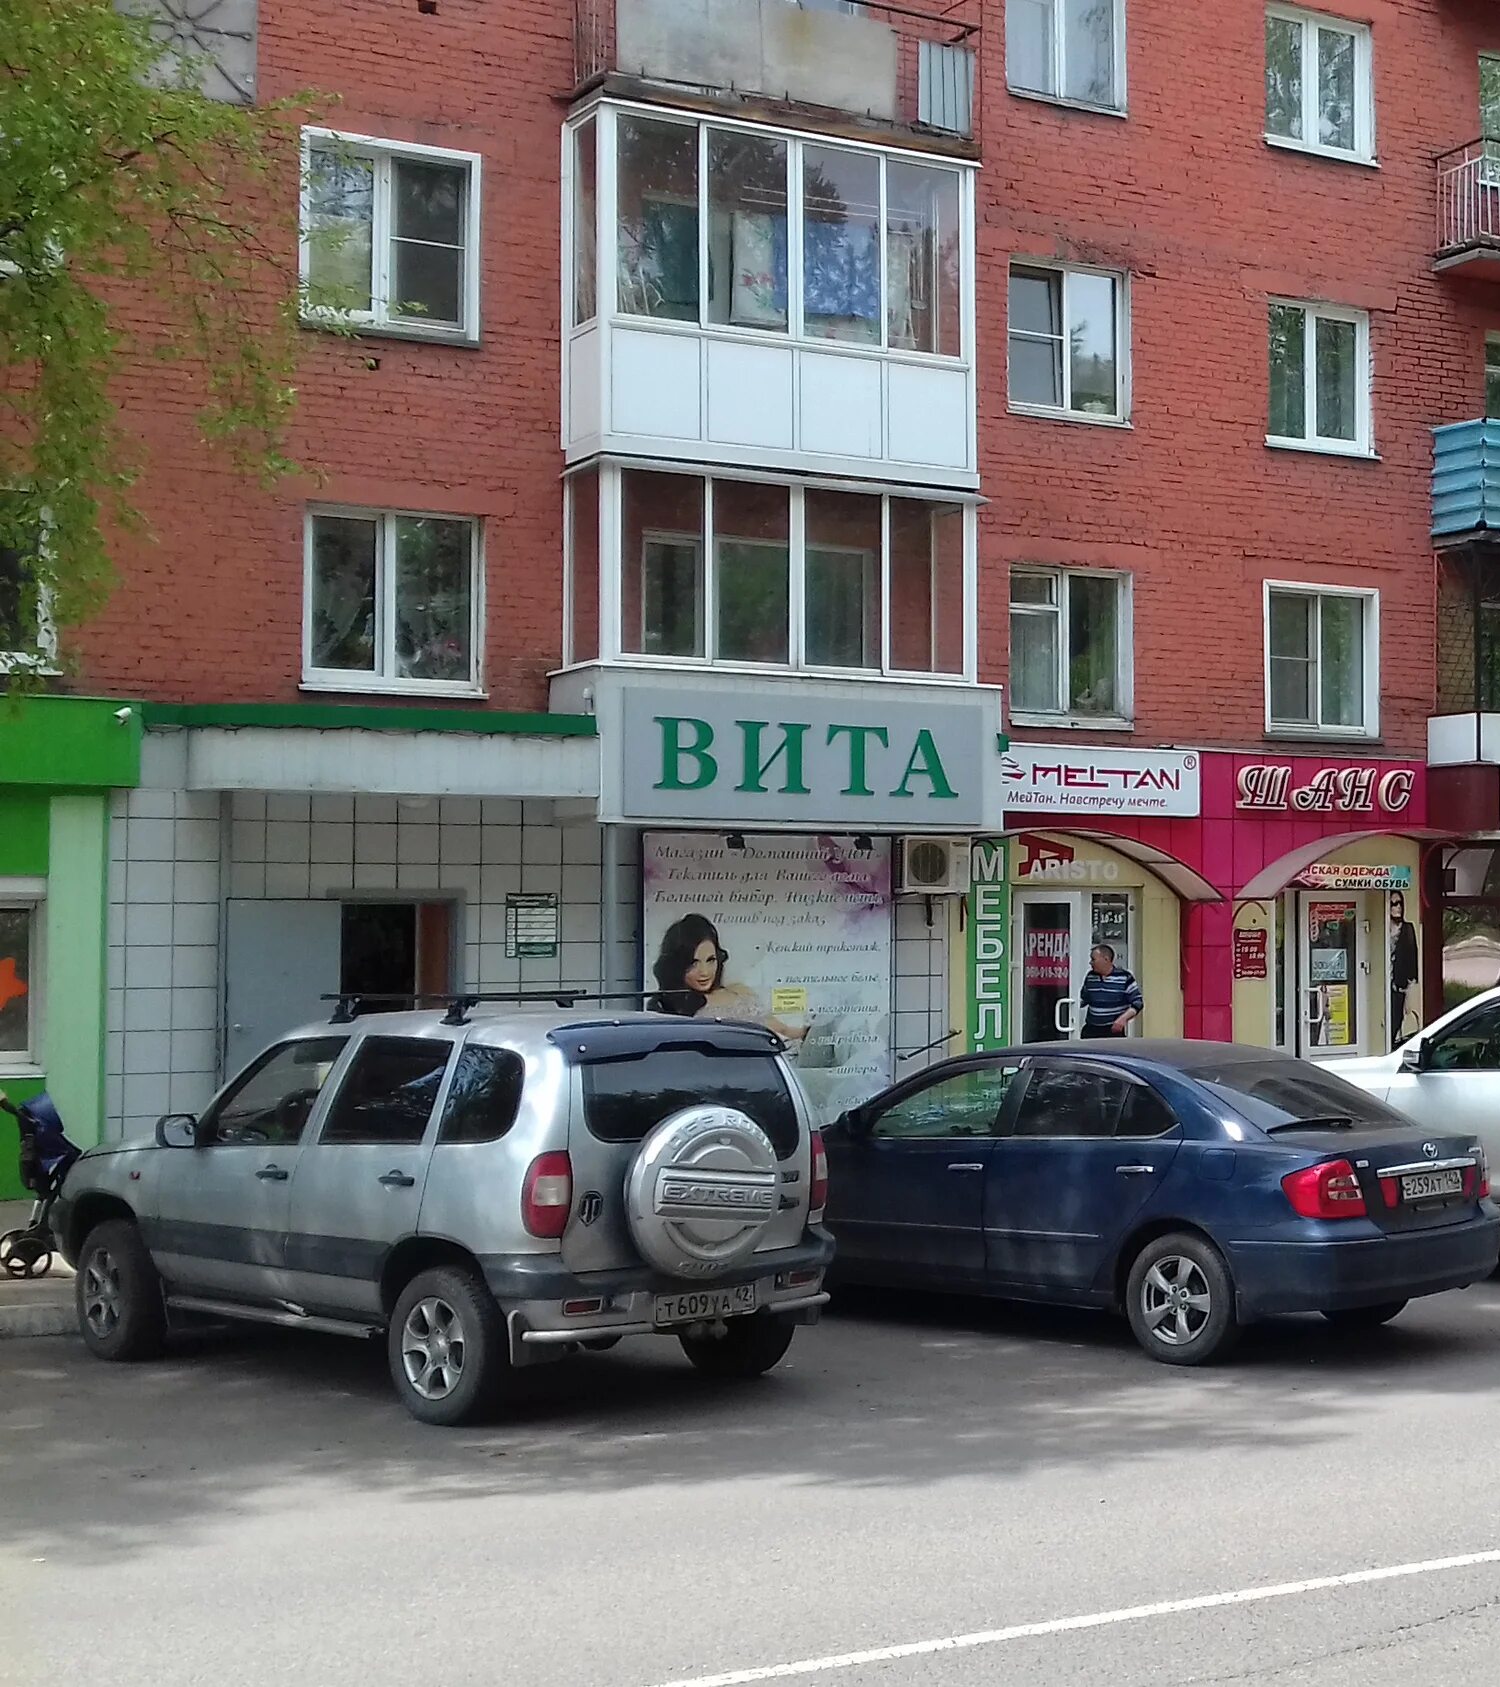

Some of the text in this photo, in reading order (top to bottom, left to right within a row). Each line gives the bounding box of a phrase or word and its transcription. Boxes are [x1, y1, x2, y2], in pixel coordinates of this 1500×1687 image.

[653, 716, 959, 798] ВИТА
[1236, 765, 1415, 811] ШАНС
[1007, 791, 1167, 808] МейТан. Навстречу мечте.
[655, 846, 724, 860] Магазин
[667, 867, 738, 880] Текстиль
[740, 870, 768, 882] для
[776, 868, 826, 881] Вашего
[1029, 859, 1119, 880] ARISTO
[1343, 866, 1390, 876] ОДЕЖДА
[1335, 878, 1409, 888] СУМКИ ОБУВЬ
[654, 889, 724, 903] Большой
[785, 890, 838, 905] Низкие
[663, 1183, 773, 1205] EXTREME
